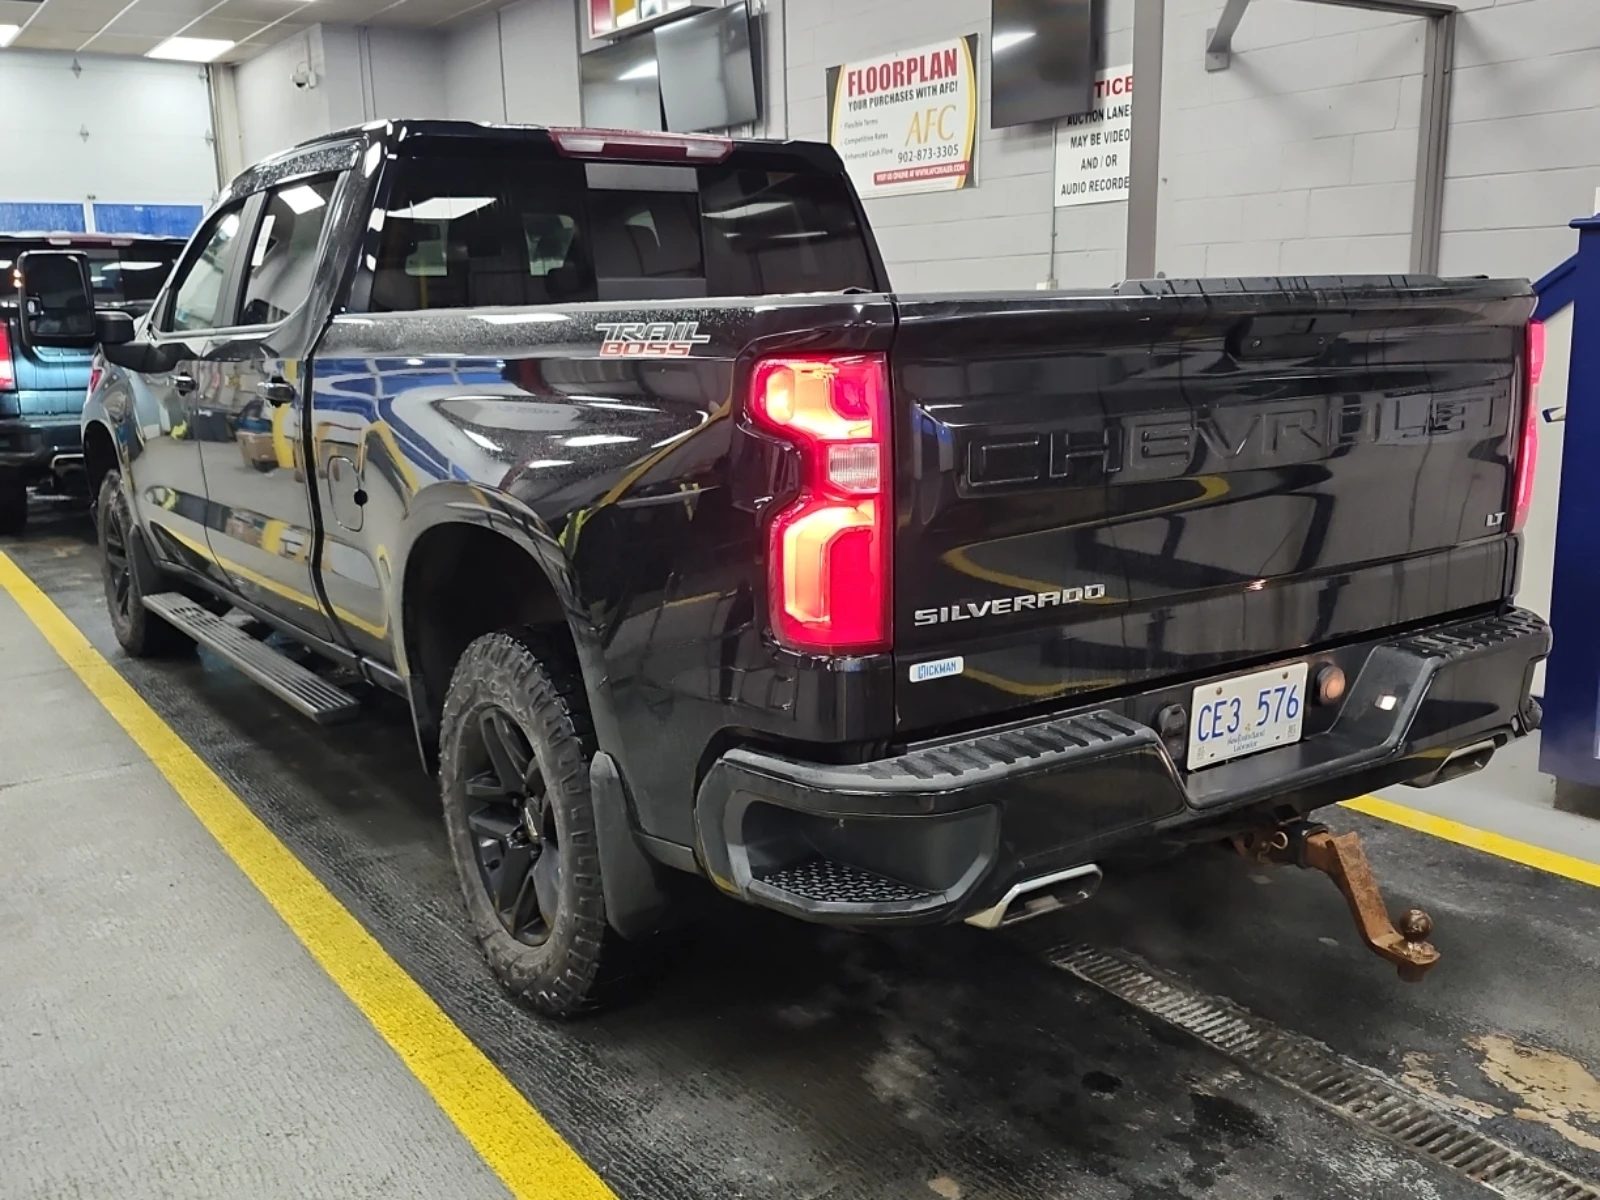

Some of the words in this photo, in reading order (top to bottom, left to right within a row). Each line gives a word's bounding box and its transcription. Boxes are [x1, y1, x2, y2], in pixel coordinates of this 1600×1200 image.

[848, 48, 958, 97] FLOORPLAN
[848, 98, 868, 112] YOUR
[869, 89, 914, 108] PURCHASES
[916, 85, 938, 100] WITH
[939, 81, 958, 95] AFC!
[1094, 75, 1133, 98] TICE
[905, 104, 957, 147] AFC
[1067, 109, 1104, 127] AUCTION
[875, 132, 889, 141] Rates
[1070, 135, 1087, 149] MAY
[1090, 132, 1101, 146] BE
[1104, 128, 1130, 144] VIDEO
[869, 149, 881, 158] Cash
[898, 144, 959, 163] 902-873-3305
[1081, 156, 1098, 171] AND
[1105, 154, 1117, 168] OR
[1061, 181, 1087, 196] AUDIO
[1089, 176, 1130, 193] RECORDE
[595, 322, 711, 343] TRAIL
[600, 341, 692, 357] BOSS
[965, 384, 1508, 487] CHEVROLET
[1486, 511, 1506, 526] LT
[914, 584, 1105, 626] SILVERADO
[1197, 697, 1242, 742] CE3
[1255, 684, 1299, 727] 576
